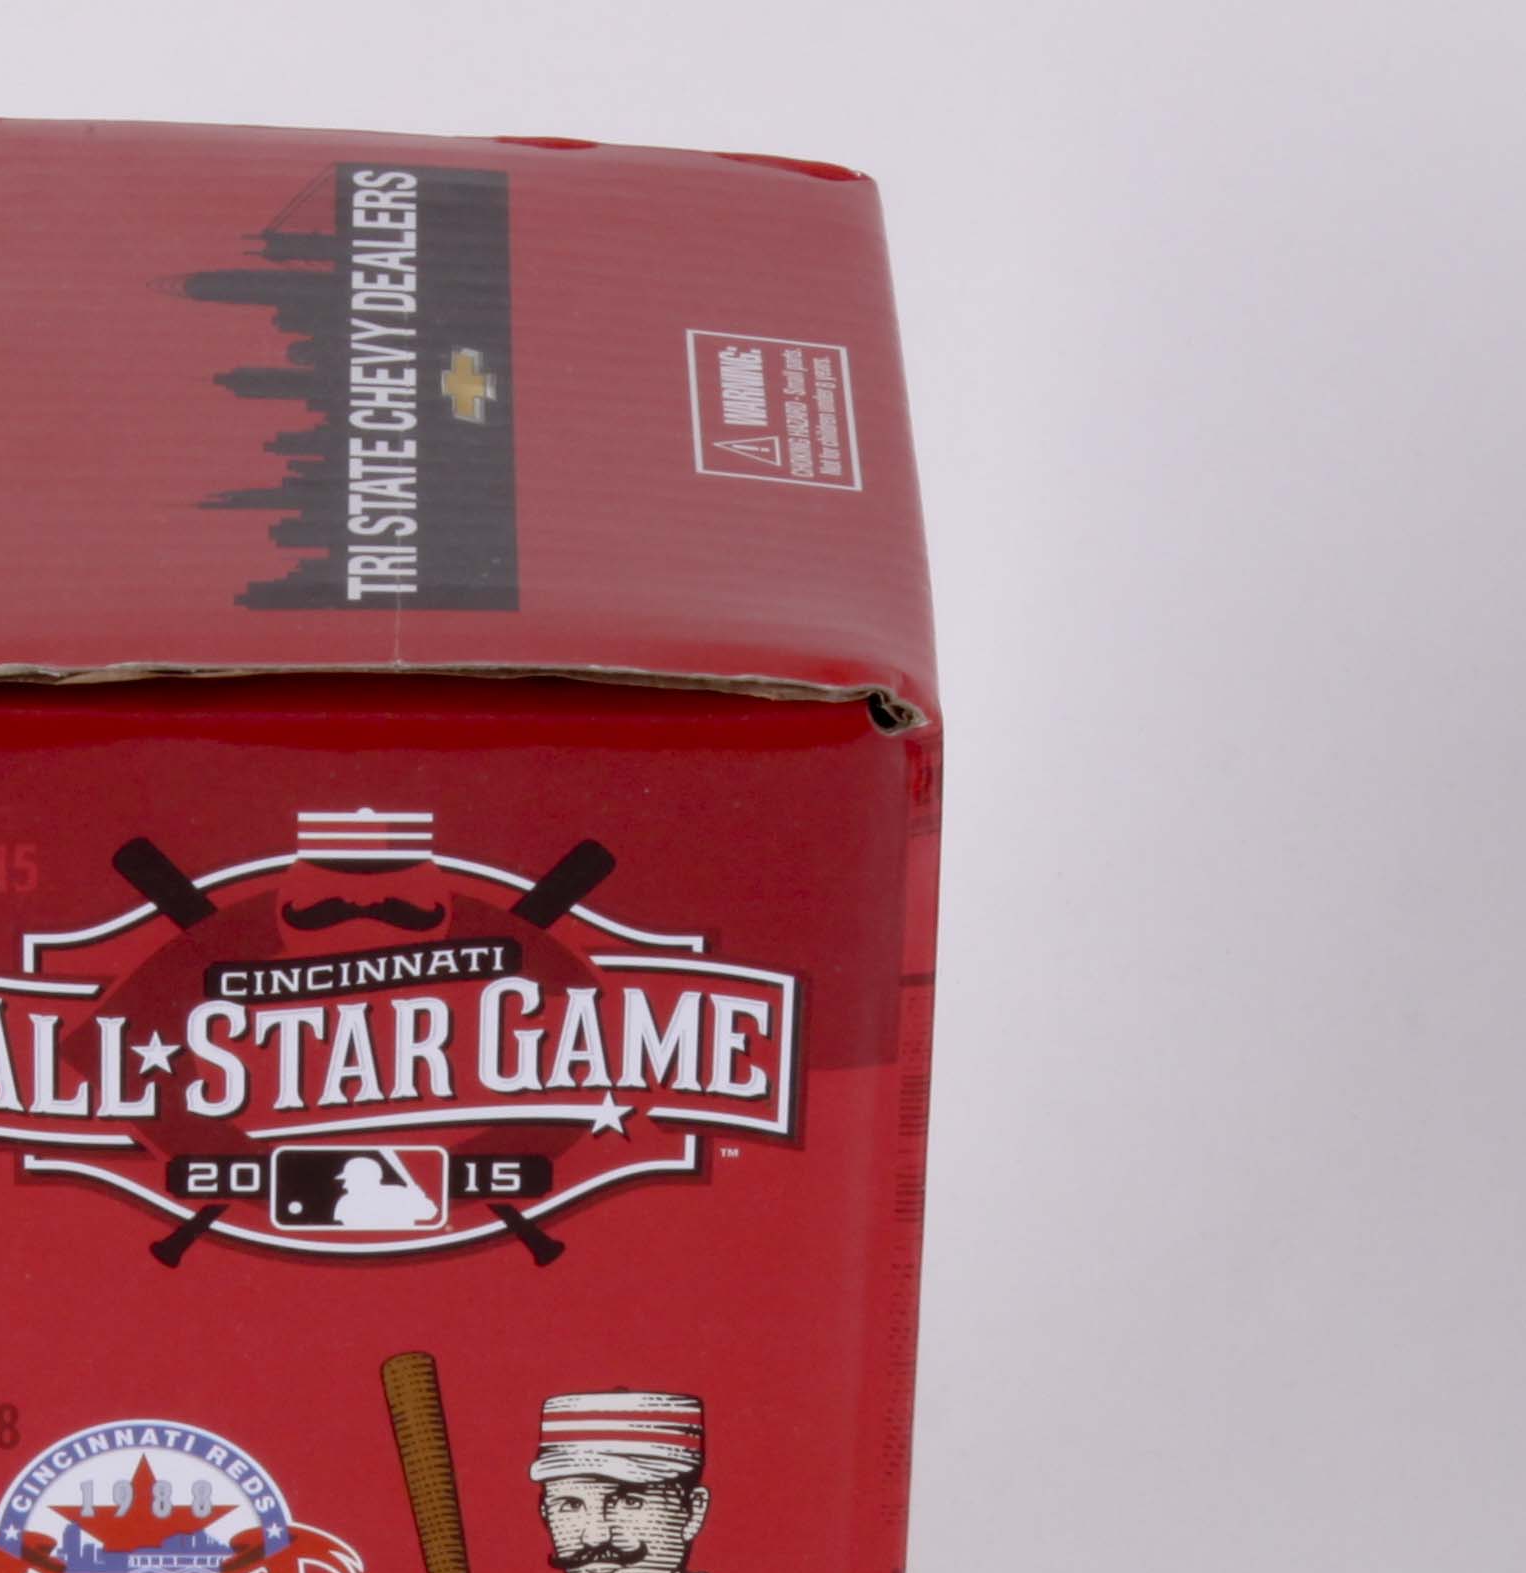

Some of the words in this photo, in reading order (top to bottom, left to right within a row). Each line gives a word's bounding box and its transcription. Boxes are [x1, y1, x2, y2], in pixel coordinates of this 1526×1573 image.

[351, 170, 417, 313] DEALERS
[349, 318, 417, 432] CHEVY
[719, 346, 768, 426] WARNING:
[347, 437, 417, 536] STATE
[347, 545, 417, 600] TRI
[220, 945, 506, 996] CINCINNATI
[476, 976, 772, 1100] GAME
[187, 1162, 261, 1193] 20
[464, 1162, 522, 1193] 15
[11, 1428, 196, 1513] CINCINNATI
[206, 1444, 275, 1513] REDS
[79, 1479, 213, 1519] 1988
